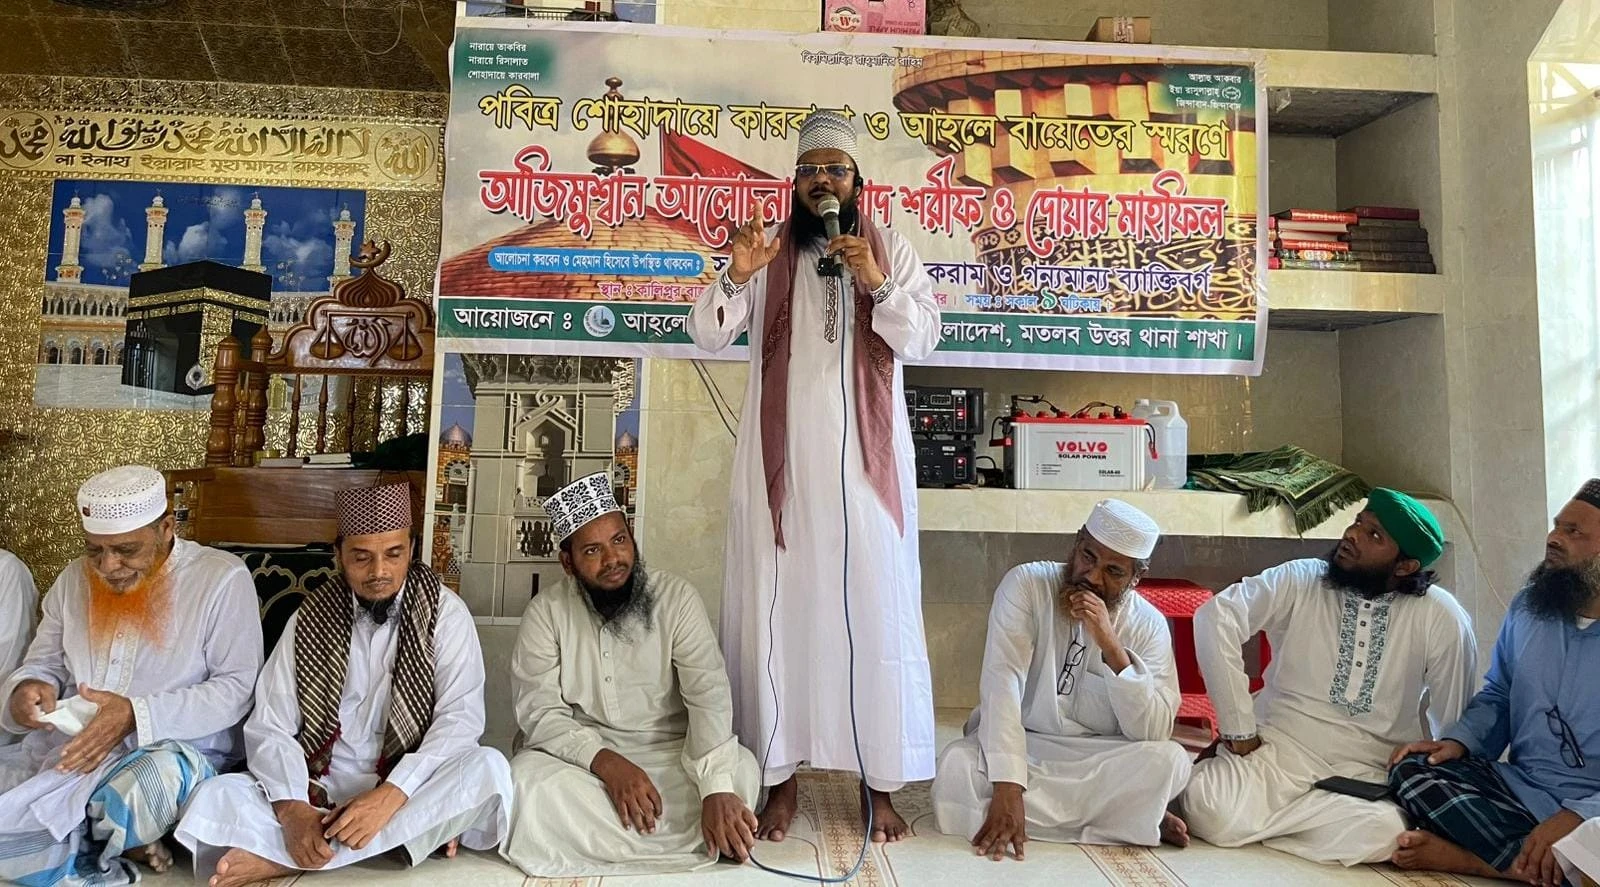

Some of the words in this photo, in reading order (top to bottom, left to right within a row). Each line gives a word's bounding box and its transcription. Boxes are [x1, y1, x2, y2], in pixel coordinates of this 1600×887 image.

[508, 72, 540, 81] কারবালা
[479, 84, 562, 130] পবিত্র
[572, 95, 721, 138] শোহাদায়ে
[863, 112, 889, 141] ও
[1009, 112, 1135, 151] বায়েতের
[1141, 120, 1231, 158] স্মরণে
[55, 154, 76, 167] লা
[899, 155, 986, 236] শরীফ
[992, 187, 1017, 232] ও
[1024, 185, 1110, 259] দোয়ার
[1115, 170, 1228, 244] মাহফিল
[494, 252, 530, 266] আলোচনা
[533, 254, 560, 266] করবেন
[572, 255, 601, 268] মেহমান
[603, 252, 630, 269] হিসেবে
[663, 258, 694, 270] থাকবেন
[995, 265, 1013, 286] ও
[599, 282, 622, 298] স্থান
[453, 306, 554, 329] আয়োজনে
[1019, 323, 1081, 346] মতলব
[1086, 321, 1132, 348] উত্তর
[1139, 326, 1179, 348] থানা
[1186, 328, 1229, 350] শাখা
[1056, 441, 1108, 453] VOLVO
